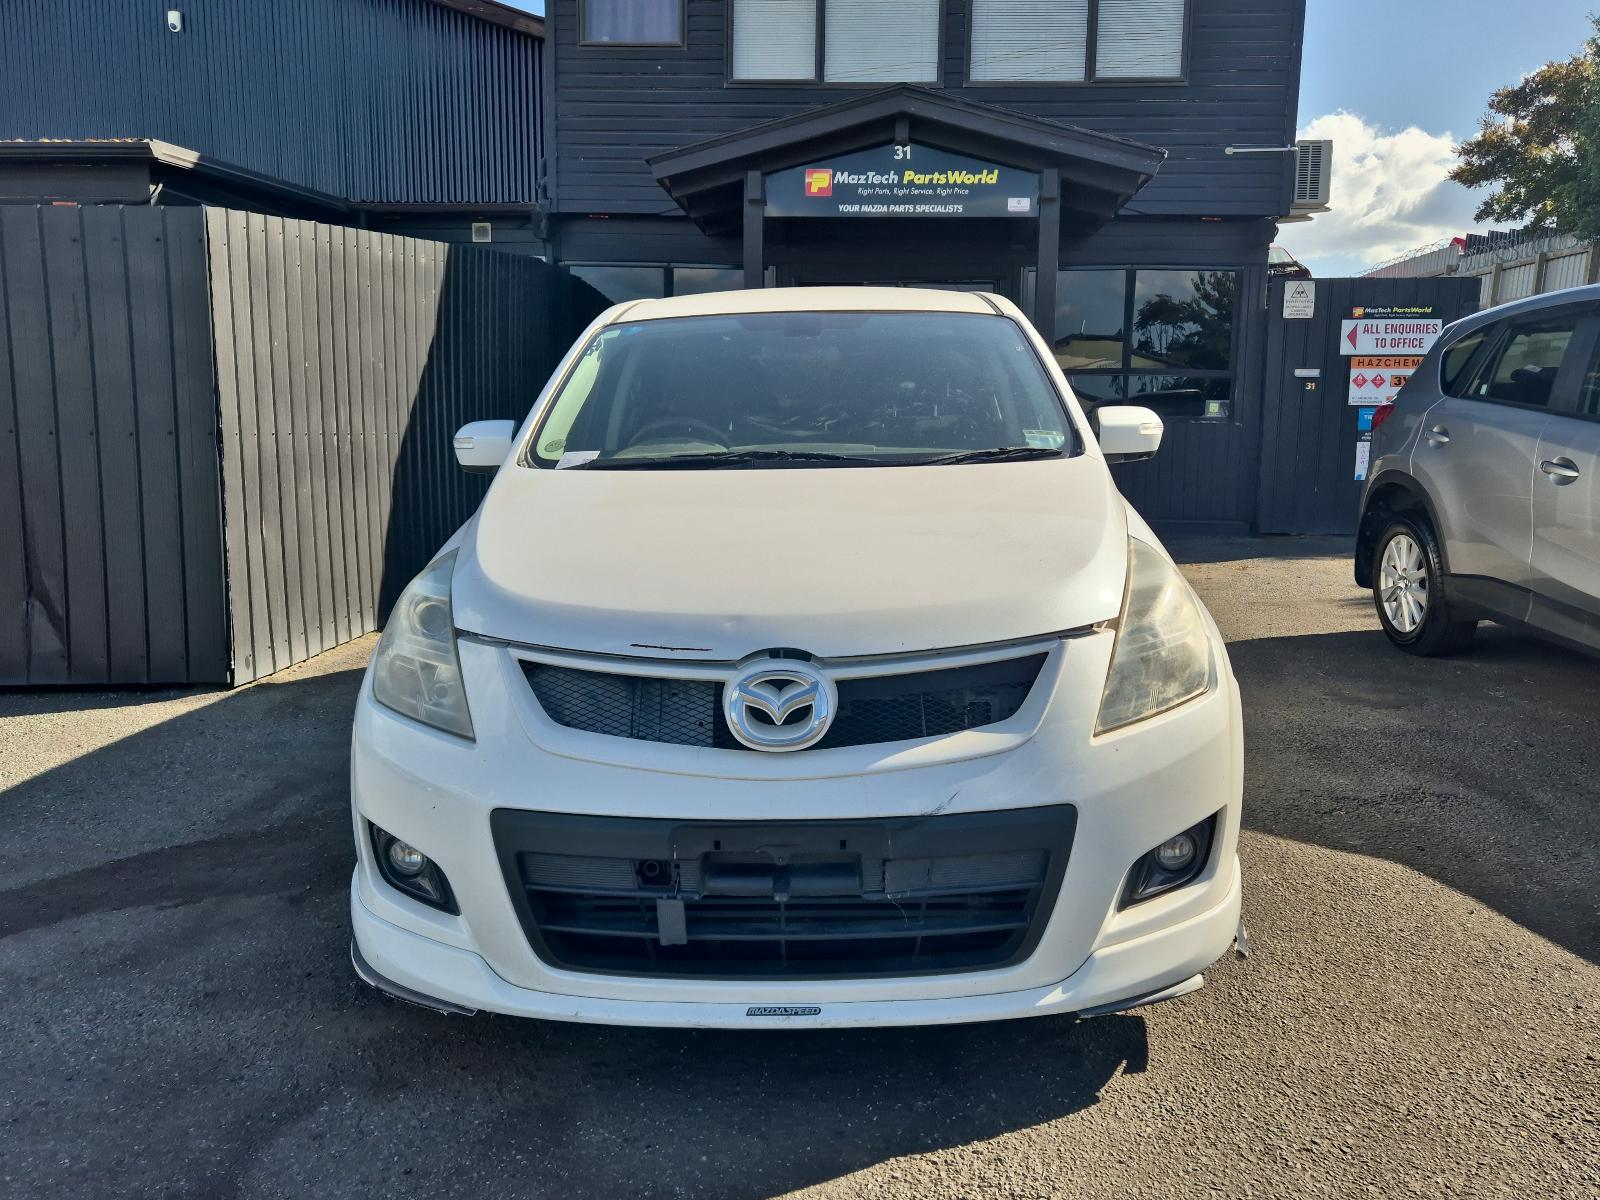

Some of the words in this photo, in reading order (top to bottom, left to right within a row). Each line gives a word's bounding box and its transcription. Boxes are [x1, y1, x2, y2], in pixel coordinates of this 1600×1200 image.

[894, 145, 911, 160] 31
[834, 171, 899, 184] MazTech
[903, 169, 999, 184] PartsWorld
[858, 187, 874, 196] Right
[875, 187, 891, 195] Parts,
[893, 187, 909, 196] Right
[936, 187, 952, 196] Right
[954, 187, 969, 195] Price
[838, 204, 860, 212] YOUR
[861, 204, 888, 212] MAZDA
[889, 204, 914, 212] PARTS
[915, 204, 963, 212] SPECIALISTS
[1362, 323, 1380, 335] ALL
[1384, 323, 1438, 335] ENQUIRIES
[1375, 337, 1387, 349] TO
[1390, 337, 1424, 349] OFFICE
[1357, 358, 1420, 367] HAZCHEM
[1305, 382, 1315, 390] 31
[747, 1007, 820, 1015] MAZDASPEED
